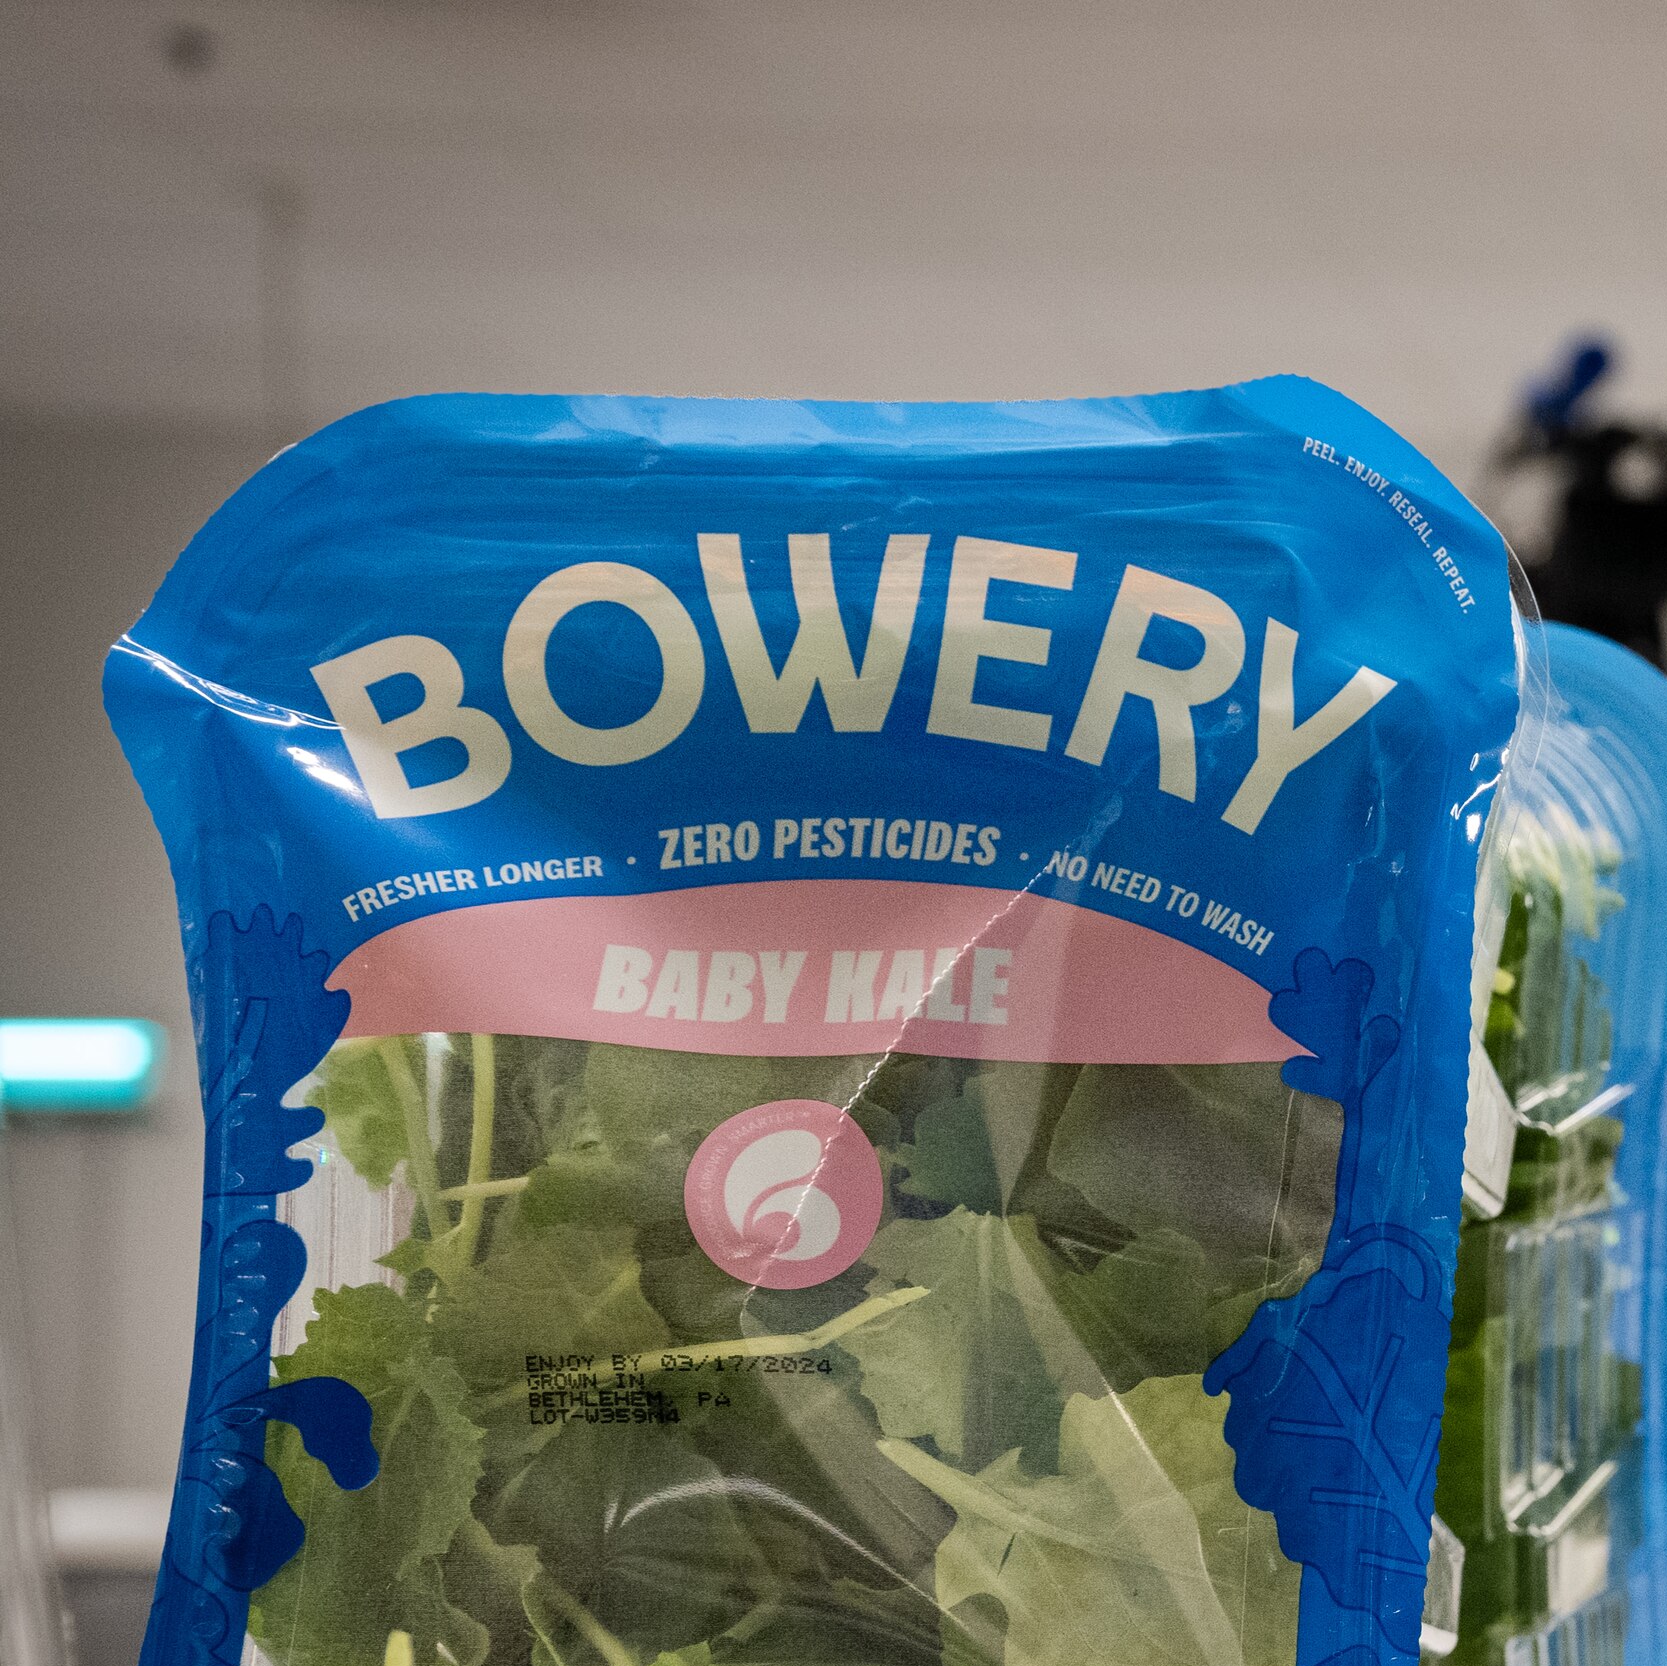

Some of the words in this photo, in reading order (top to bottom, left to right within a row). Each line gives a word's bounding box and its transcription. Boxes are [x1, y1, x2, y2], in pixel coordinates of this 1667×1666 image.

[1303, 437, 1339, 465] PEEL.
[1344, 456, 1390, 497] ENJOY.
[1388, 490, 1433, 549] RESEAL.
[1432, 546, 1476, 614] REPEAT.
[309, 532, 1398, 836] BOWERY
[341, 868, 478, 922] FRESHER
[483, 855, 603, 887] LONGER
[658, 820, 760, 871] ZERO
[773, 817, 1001, 867] PESTICIDES
[1047, 850, 1087, 882] NO
[1092, 862, 1161, 904] NEED
[1164, 883, 1200, 918] TO
[1200, 900, 1275, 956] WASH
[592, 944, 808, 1023] BABY
[824, 947, 1013, 1025] KALE
[526, 1354, 595, 1372] ENJOY
[612, 1354, 642, 1371] BY
[660, 1354, 833, 1375] 03/17/2024
[527, 1374, 597, 1390] GROWN
[616, 1373, 645, 1389] IN
[697, 1392, 731, 1408] PA
